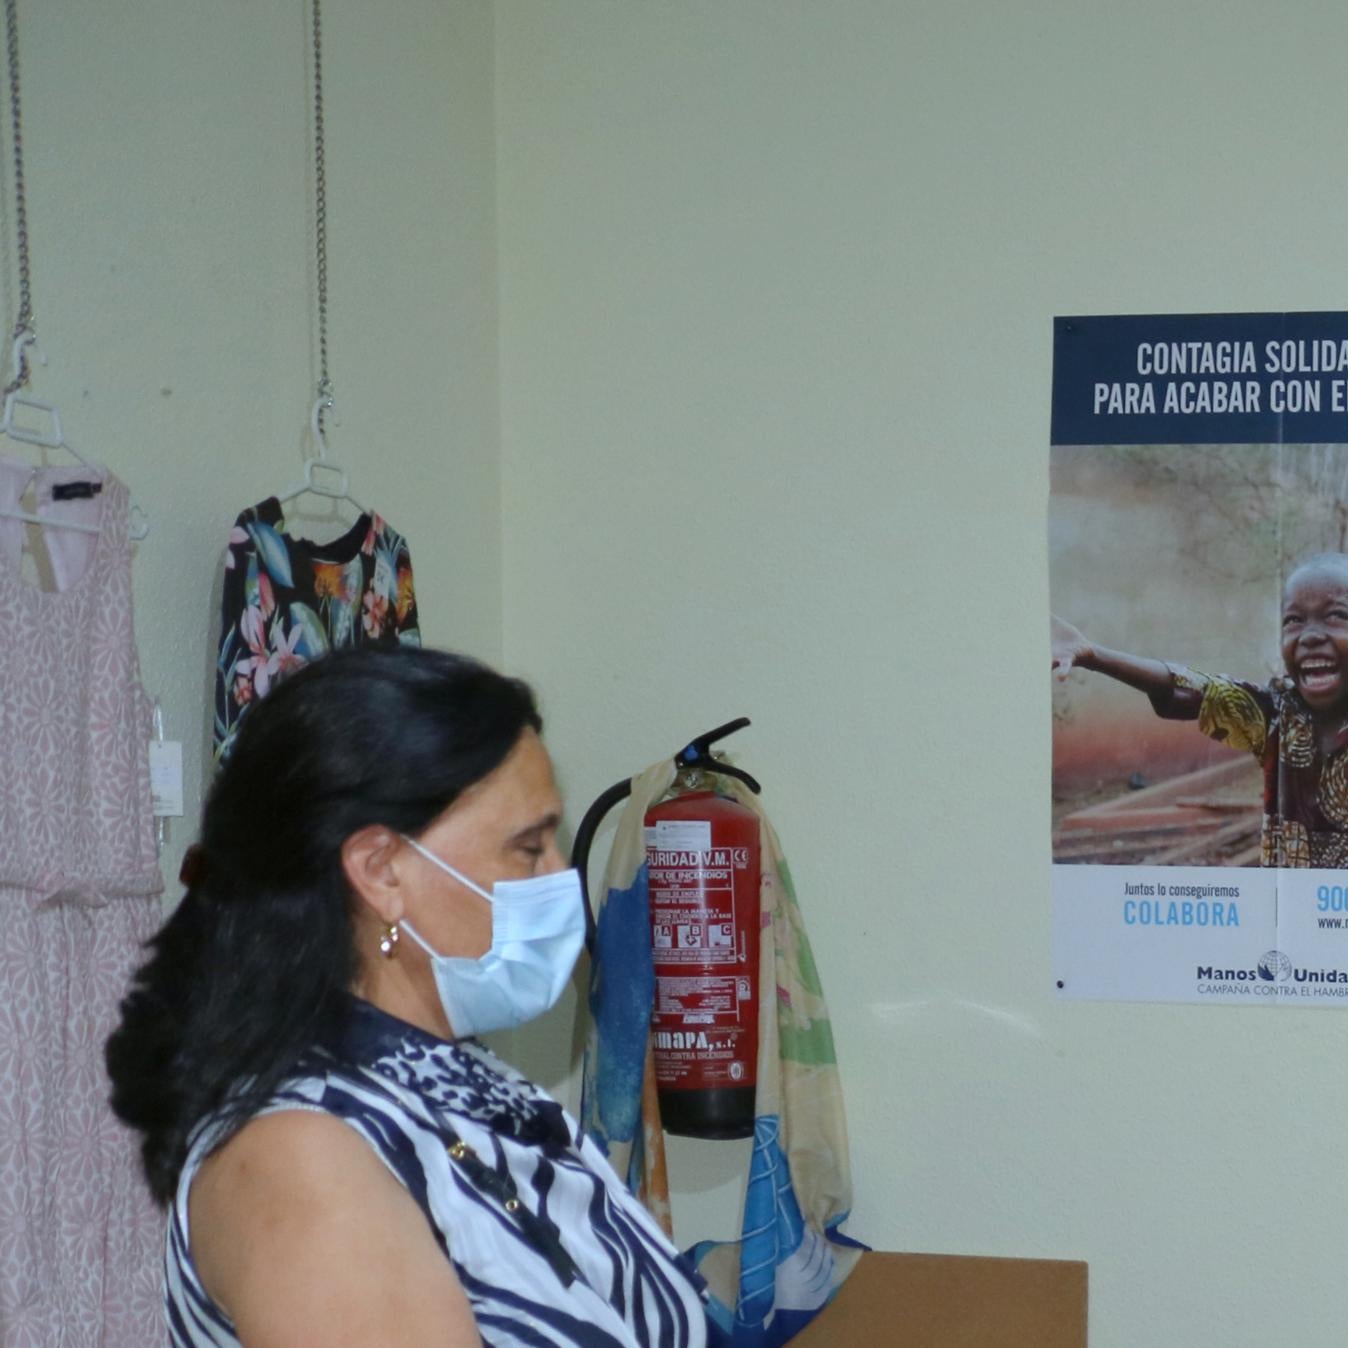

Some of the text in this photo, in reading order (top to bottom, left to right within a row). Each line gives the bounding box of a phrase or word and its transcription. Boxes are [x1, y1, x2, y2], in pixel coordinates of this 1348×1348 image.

[1137, 341, 1257, 375] CONTAGIA
[1093, 382, 1156, 415] PARA
[1163, 380, 1261, 414] ACABAR
[1269, 379, 1321, 413] CON
[678, 871, 728, 880] INCENDIOS
[1124, 882, 1240, 900] Juntos lo conseguiremos
[1123, 900, 1240, 927] COLABORA
[692, 926, 700, 936] B
[722, 925, 731, 935] C
[1197, 966, 1257, 981] Manos
[1197, 982, 1250, 995] CAMPAÑA
[1253, 985, 1298, 996] CONTRA
[1301, 985, 1311, 996] EL
